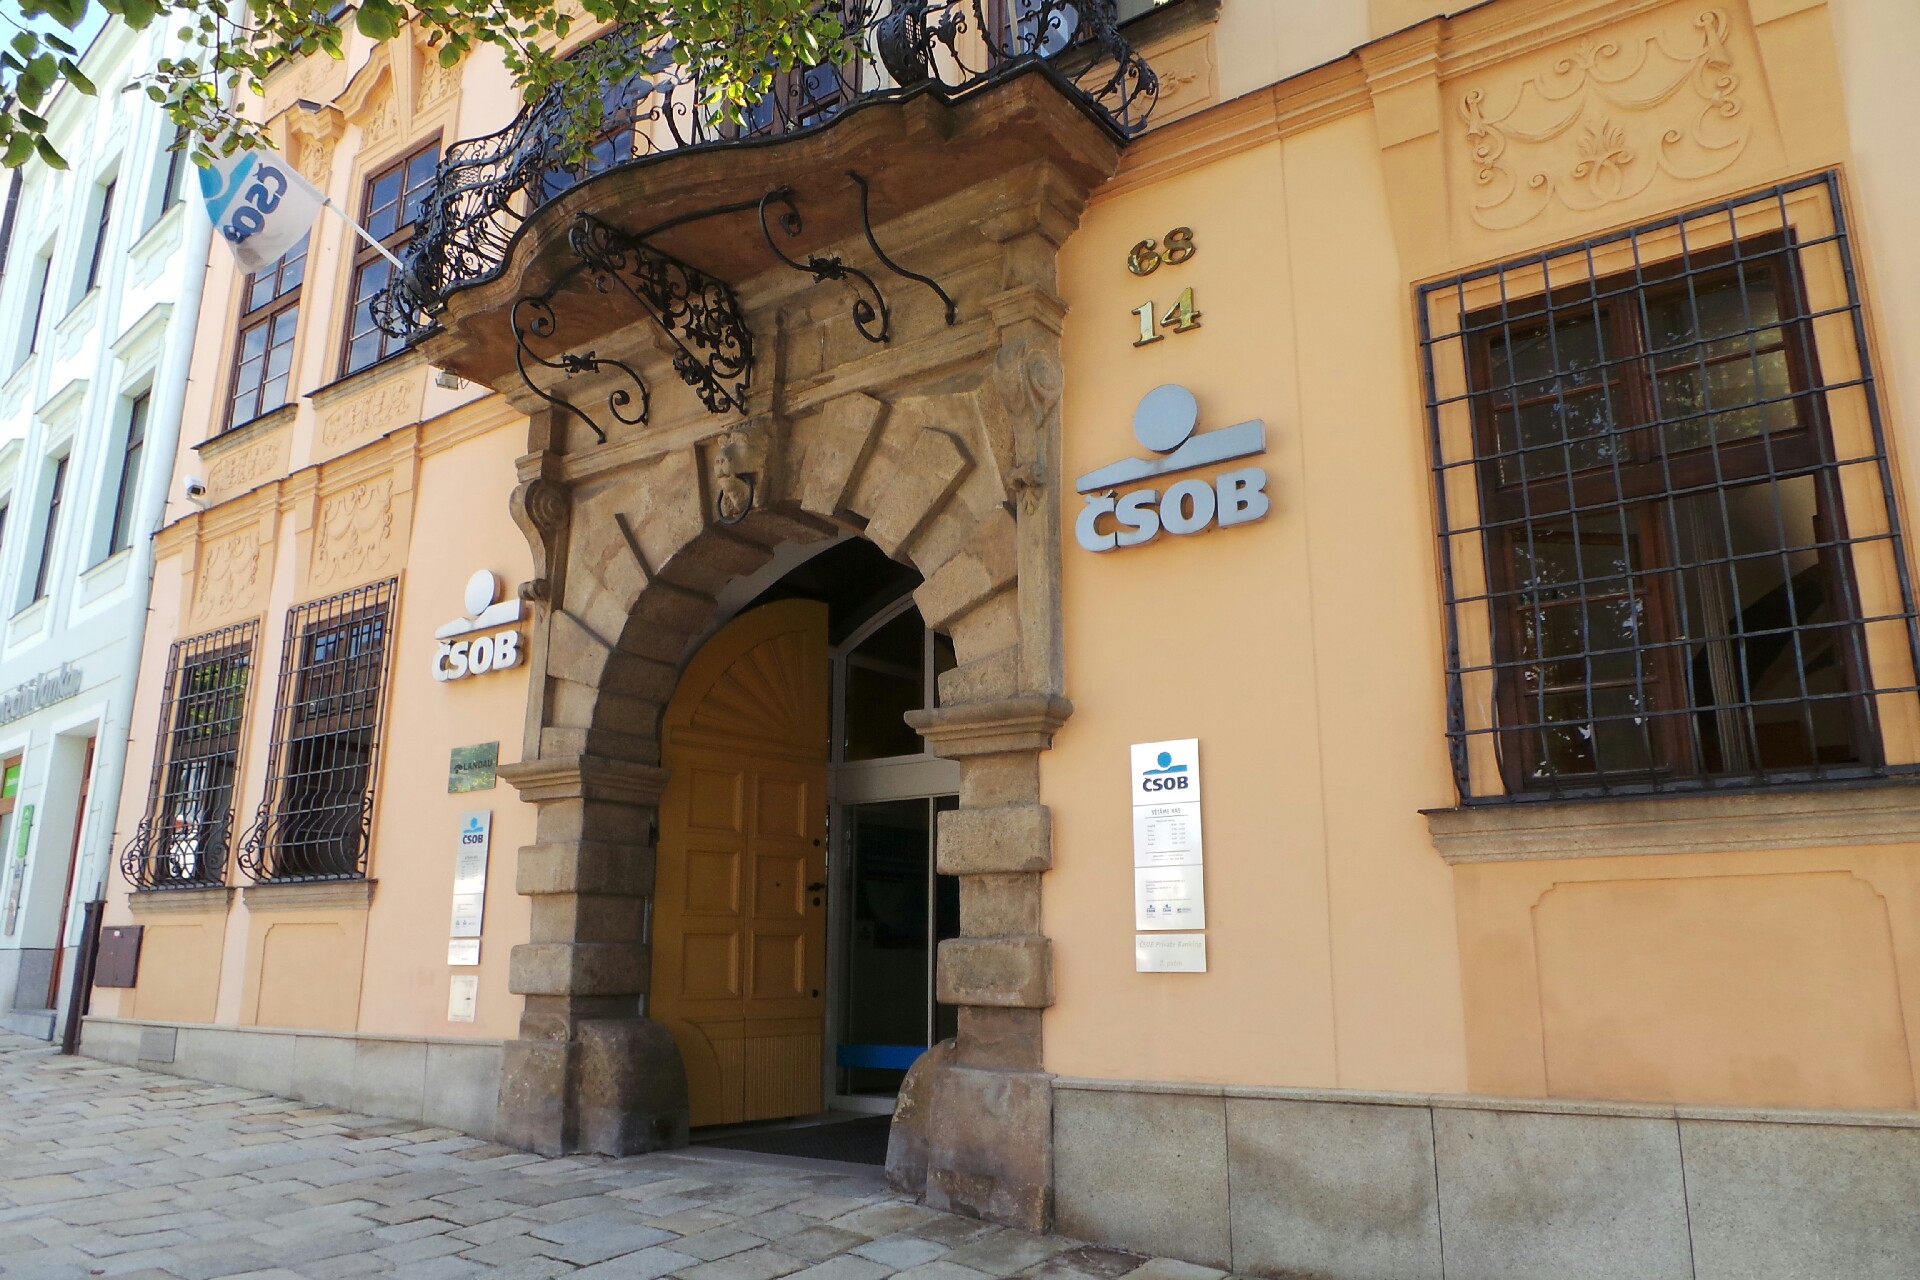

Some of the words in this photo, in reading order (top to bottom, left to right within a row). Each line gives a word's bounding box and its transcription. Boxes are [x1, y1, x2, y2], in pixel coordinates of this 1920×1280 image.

[1127, 226, 1196, 277] 68
[1131, 286, 1201, 347] 14
[1075, 467, 1271, 553] ČSOB
[432, 630, 524, 682] ČSOB
[463, 759, 493, 771] LANDAU
[1142, 776, 1189, 793] ČSOB
